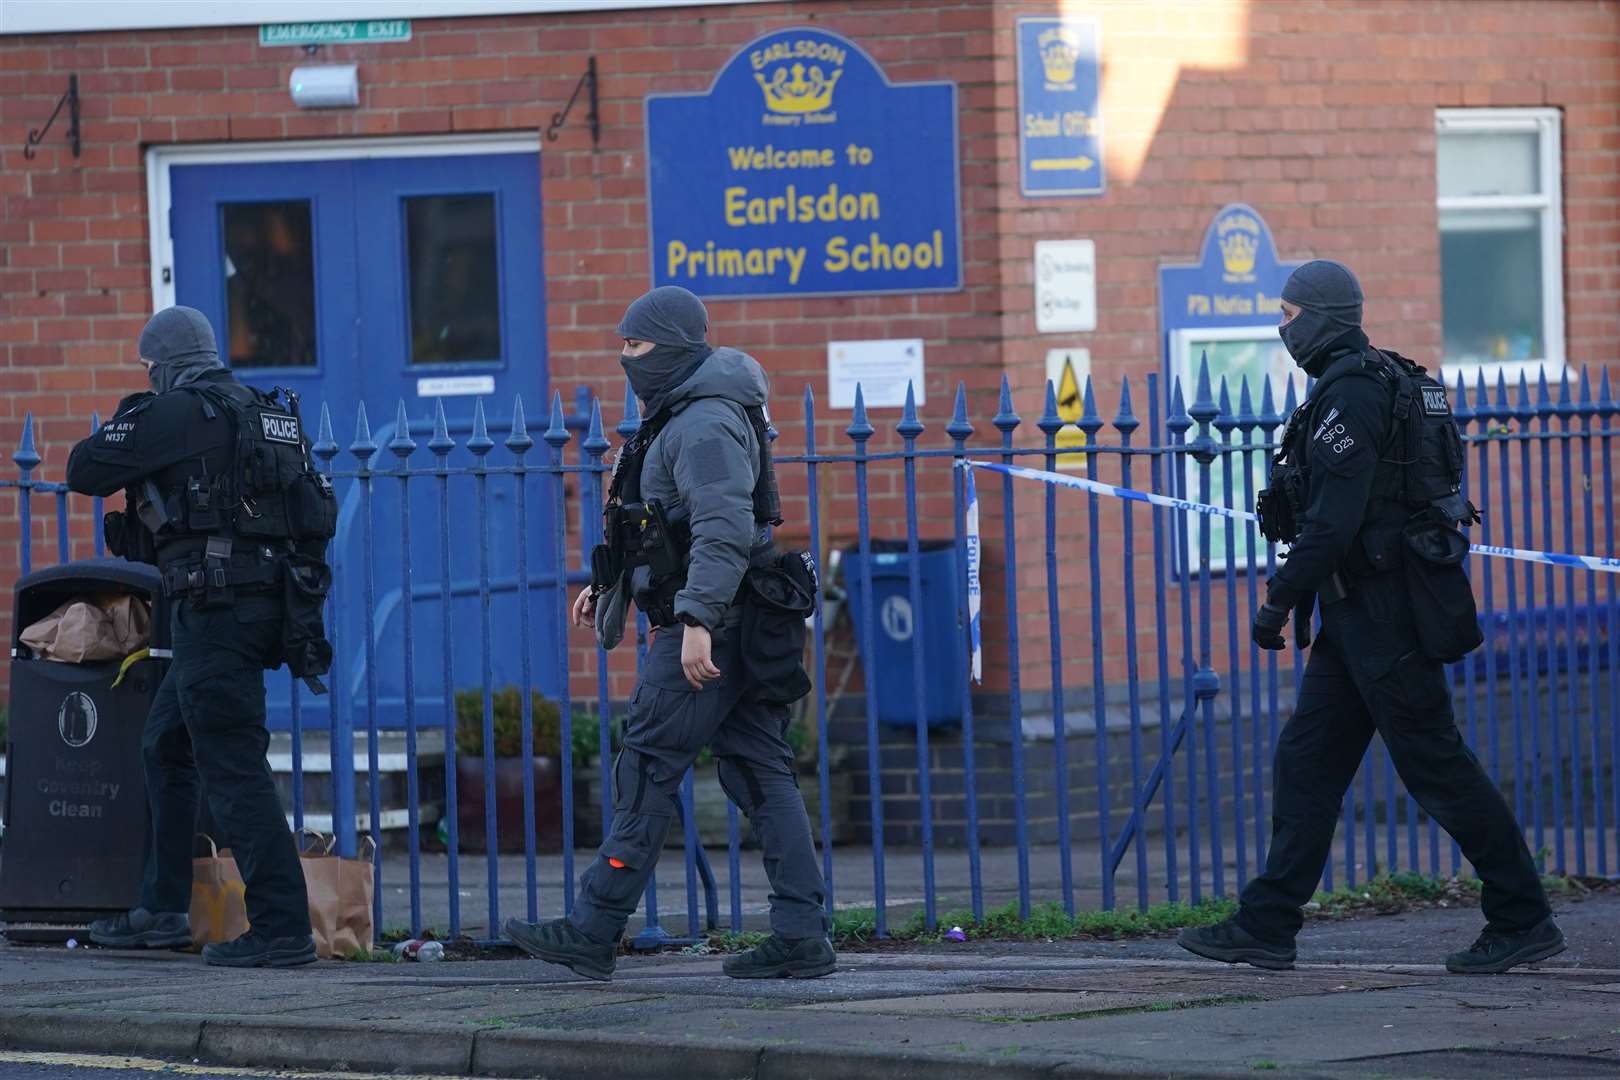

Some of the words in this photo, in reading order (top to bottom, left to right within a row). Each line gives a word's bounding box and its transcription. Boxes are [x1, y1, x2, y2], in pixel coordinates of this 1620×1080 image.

[267, 21, 359, 40] EMERGENCY
[367, 19, 405, 37] EXIT
[751, 40, 846, 70] EARLSDON
[728, 144, 835, 171] Welcome
[846, 143, 873, 166] to
[724, 183, 880, 227] Earlsdon
[667, 240, 806, 286] Primary
[824, 230, 944, 272] School
[1423, 391, 1447, 410] POLICE
[117, 422, 135, 431] ARV
[264, 417, 298, 439] POLICE
[1322, 423, 1345, 444] SFO
[105, 433, 127, 442] N137
[967, 535, 979, 596] POLICE
[48, 800, 103, 817] Clean
